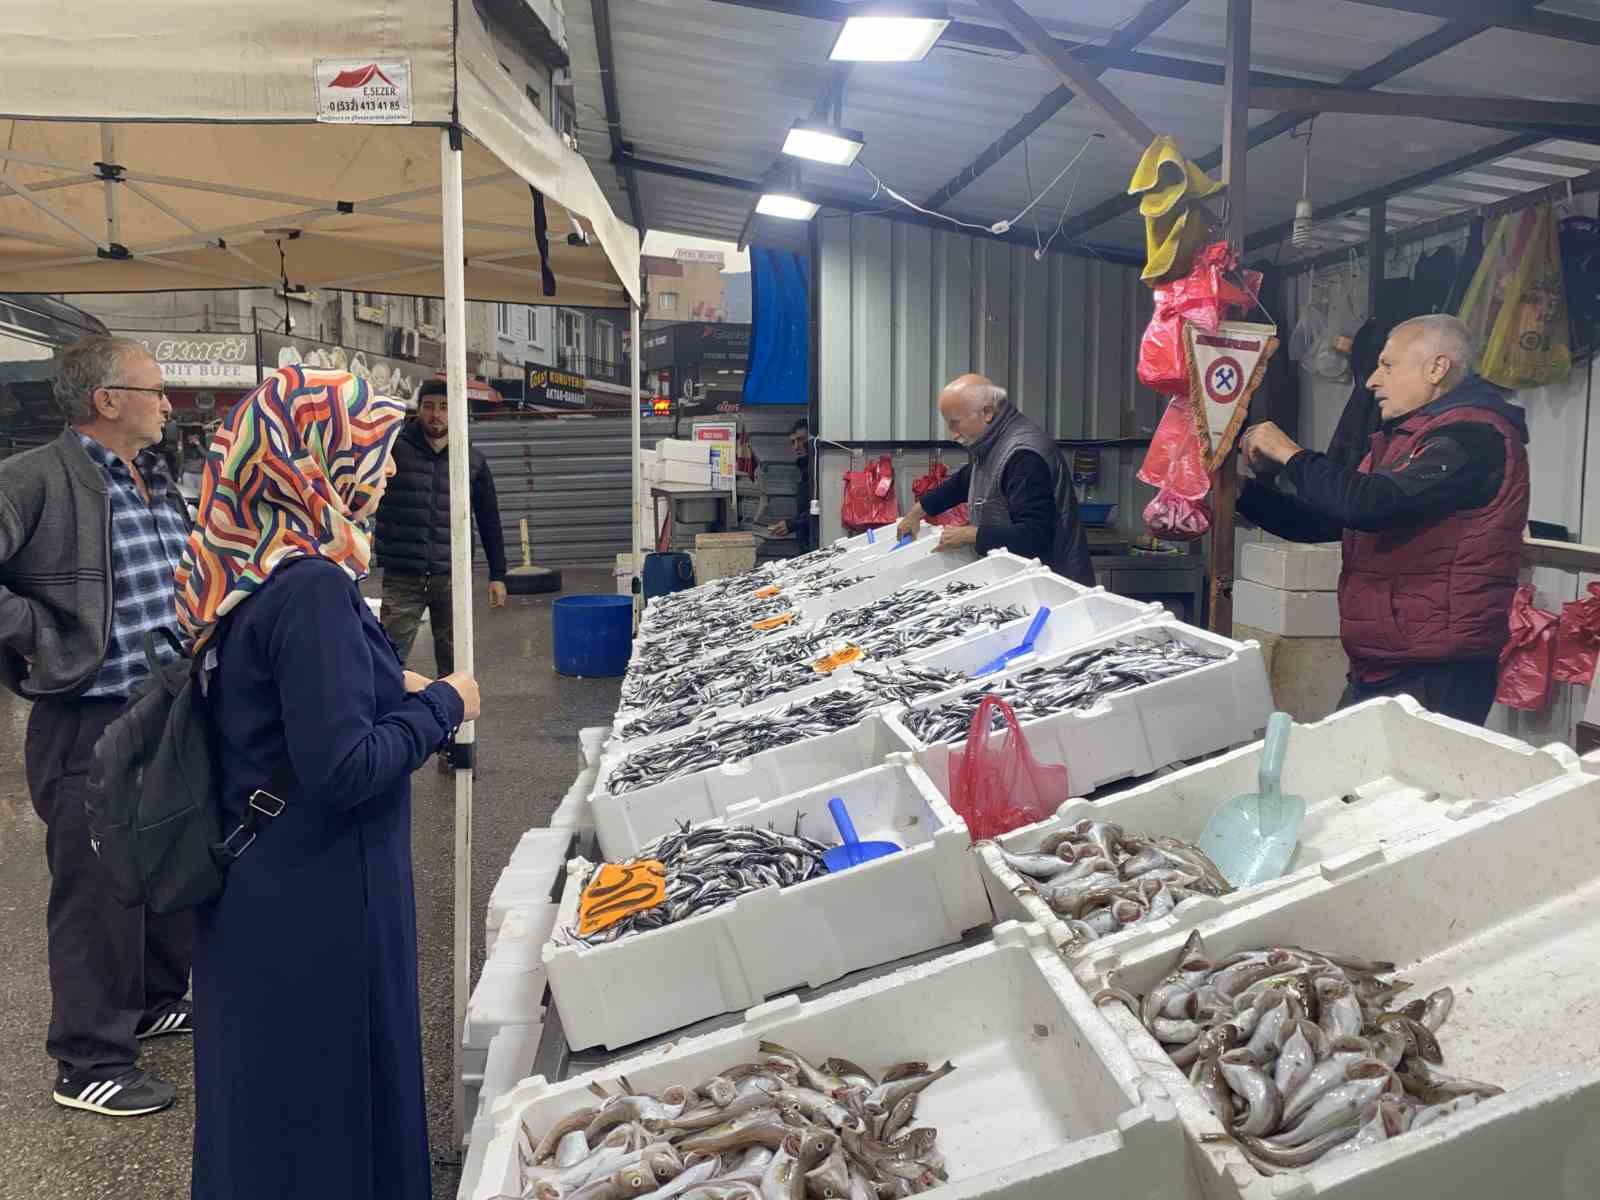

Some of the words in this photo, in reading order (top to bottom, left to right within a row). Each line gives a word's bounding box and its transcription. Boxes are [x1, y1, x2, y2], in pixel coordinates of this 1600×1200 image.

[363, 87, 397, 96] E.SEZER
[329, 102, 336, 111] 0
[337, 101, 359, 112] (532)
[360, 101, 376, 111] 413
[378, 101, 387, 111] 41
[161, 365, 193, 376] NIT
